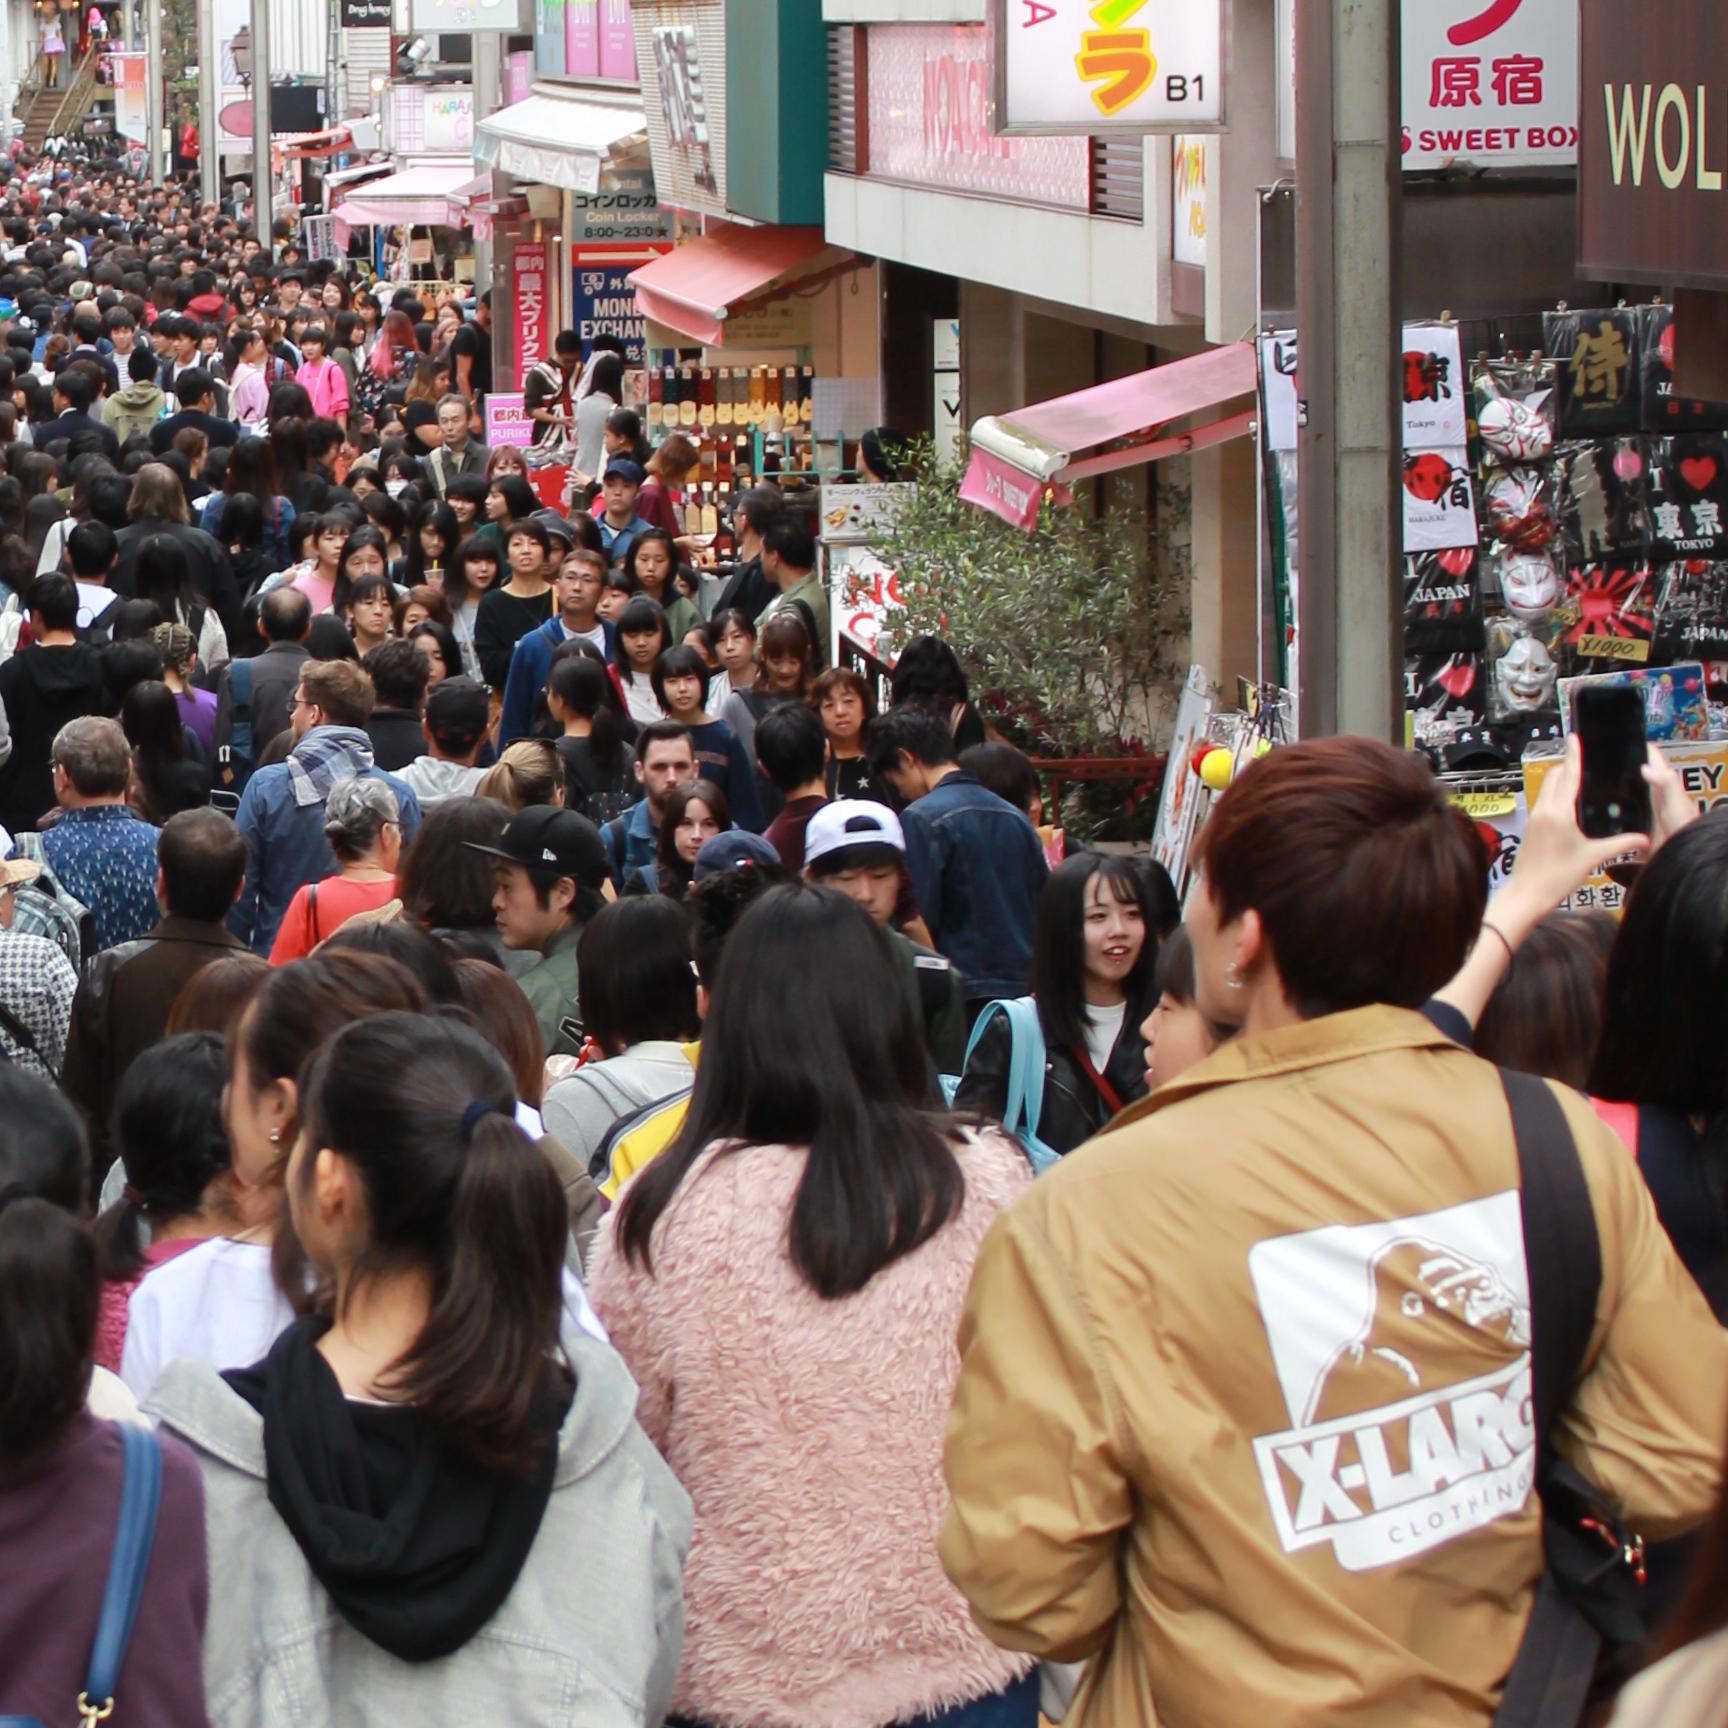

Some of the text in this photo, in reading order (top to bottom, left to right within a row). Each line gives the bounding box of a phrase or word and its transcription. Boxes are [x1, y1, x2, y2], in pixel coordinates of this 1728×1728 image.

[1166, 74, 1205, 103] B1
[1428, 52, 1545, 109] 原宿
[1418, 127, 1518, 153] SWEET
[1604, 83, 1723, 192] WOL
[585, 211, 614, 224] Coin
[1568, 320, 1628, 400] 侍
[1653, 498, 1724, 540] 東京
[1673, 539, 1714, 551] TOKYO
[1415, 583, 1471, 602] JAPAN
